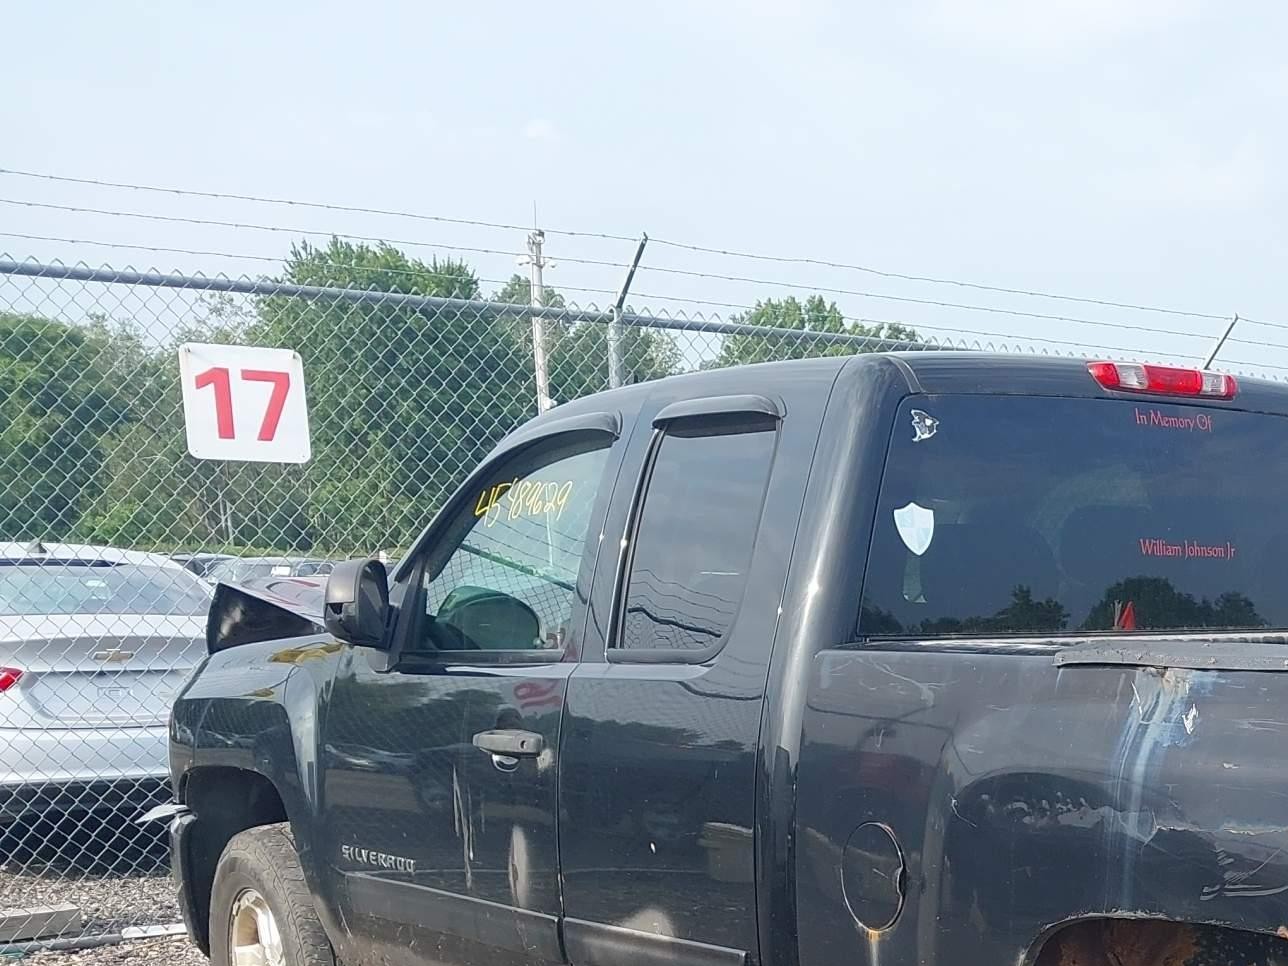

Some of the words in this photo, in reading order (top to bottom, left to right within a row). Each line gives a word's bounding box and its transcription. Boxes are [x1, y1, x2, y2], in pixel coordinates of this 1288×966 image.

[195, 367, 291, 442] 17
[1135, 407, 1148, 425] In
[1150, 409, 1195, 432] Memory
[1196, 413, 1212, 432] Of
[1140, 538, 1181, 556] William
[1184, 540, 1225, 560] Johnson
[1226, 541, 1236, 560] Jr
[341, 844, 417, 873] SILVERADO
